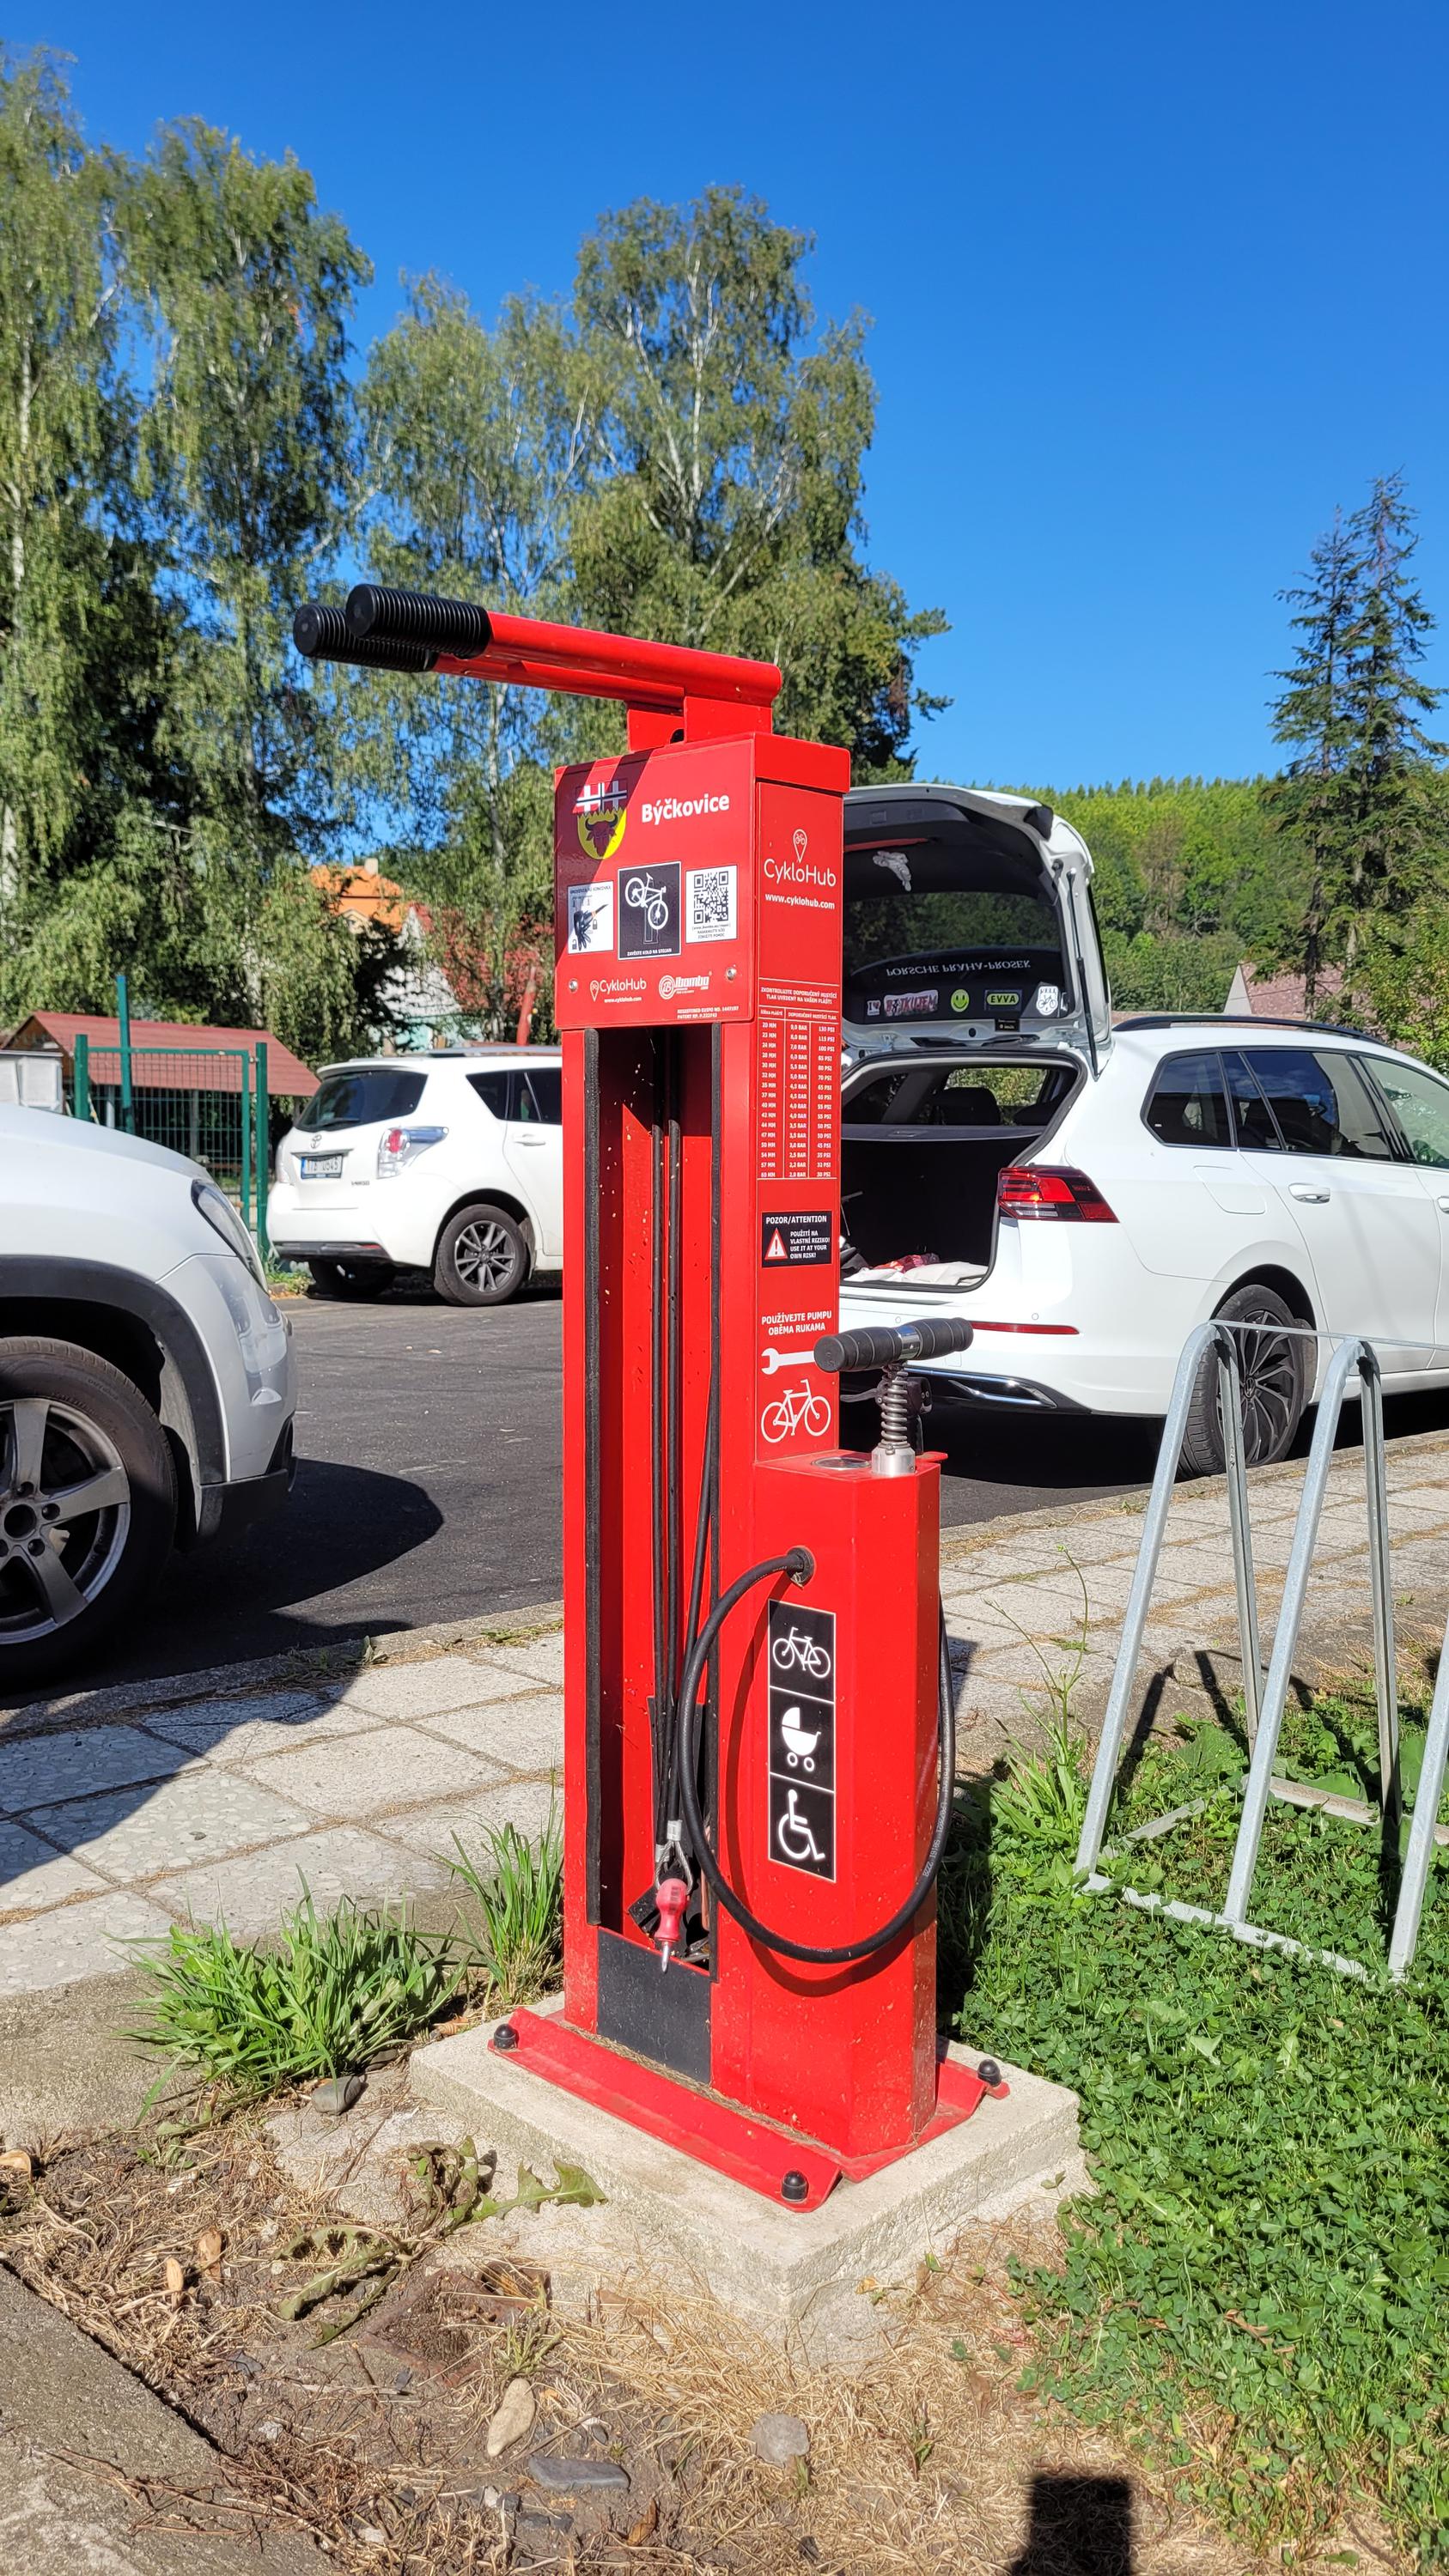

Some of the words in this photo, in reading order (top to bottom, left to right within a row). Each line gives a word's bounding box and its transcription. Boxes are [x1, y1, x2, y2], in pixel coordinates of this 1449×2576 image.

[642, 793, 729, 825] Býčkovice
[764, 859, 836, 886] CykloHub
[765, 894, 835, 909] www.cyklohub.com
[600, 977, 647, 994] CykloHub
[766, 1215, 826, 1224] POZOR/ATTENTION
[762, 1312, 806, 1325] POUŽÍVEJTE
[807, 1310, 831, 1320] PUMPU
[769, 1324, 794, 1335] OBĚMA
[795, 1322, 825, 1333] RUKAMA
